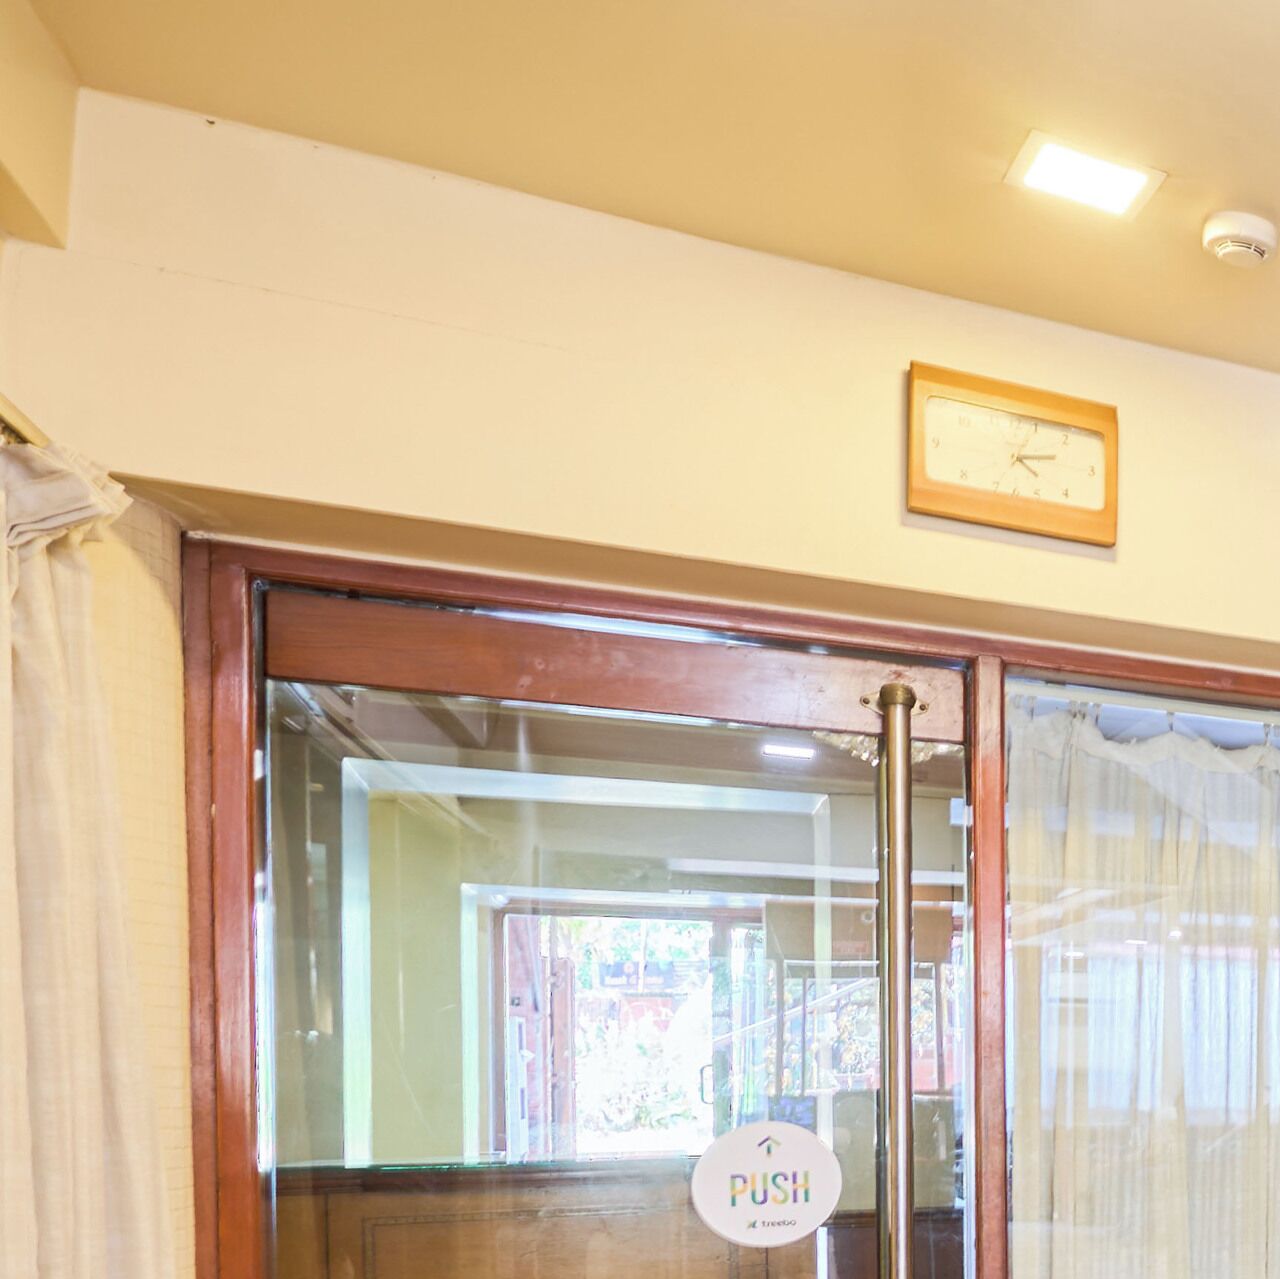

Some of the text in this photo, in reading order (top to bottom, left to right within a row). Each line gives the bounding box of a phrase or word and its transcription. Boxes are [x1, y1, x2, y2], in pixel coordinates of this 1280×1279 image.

[1009, 418, 1023, 430] 12
[1032, 422, 1038, 432] 1
[932, 437, 940, 448] 9
[1062, 434, 1069, 445] 2
[960, 468, 968, 479] 8
[1088, 465, 1096, 477] 3
[1062, 488, 1069, 498] 4
[730, 1170, 810, 1207] PUSH
[761, 1219, 797, 1228] treebo
